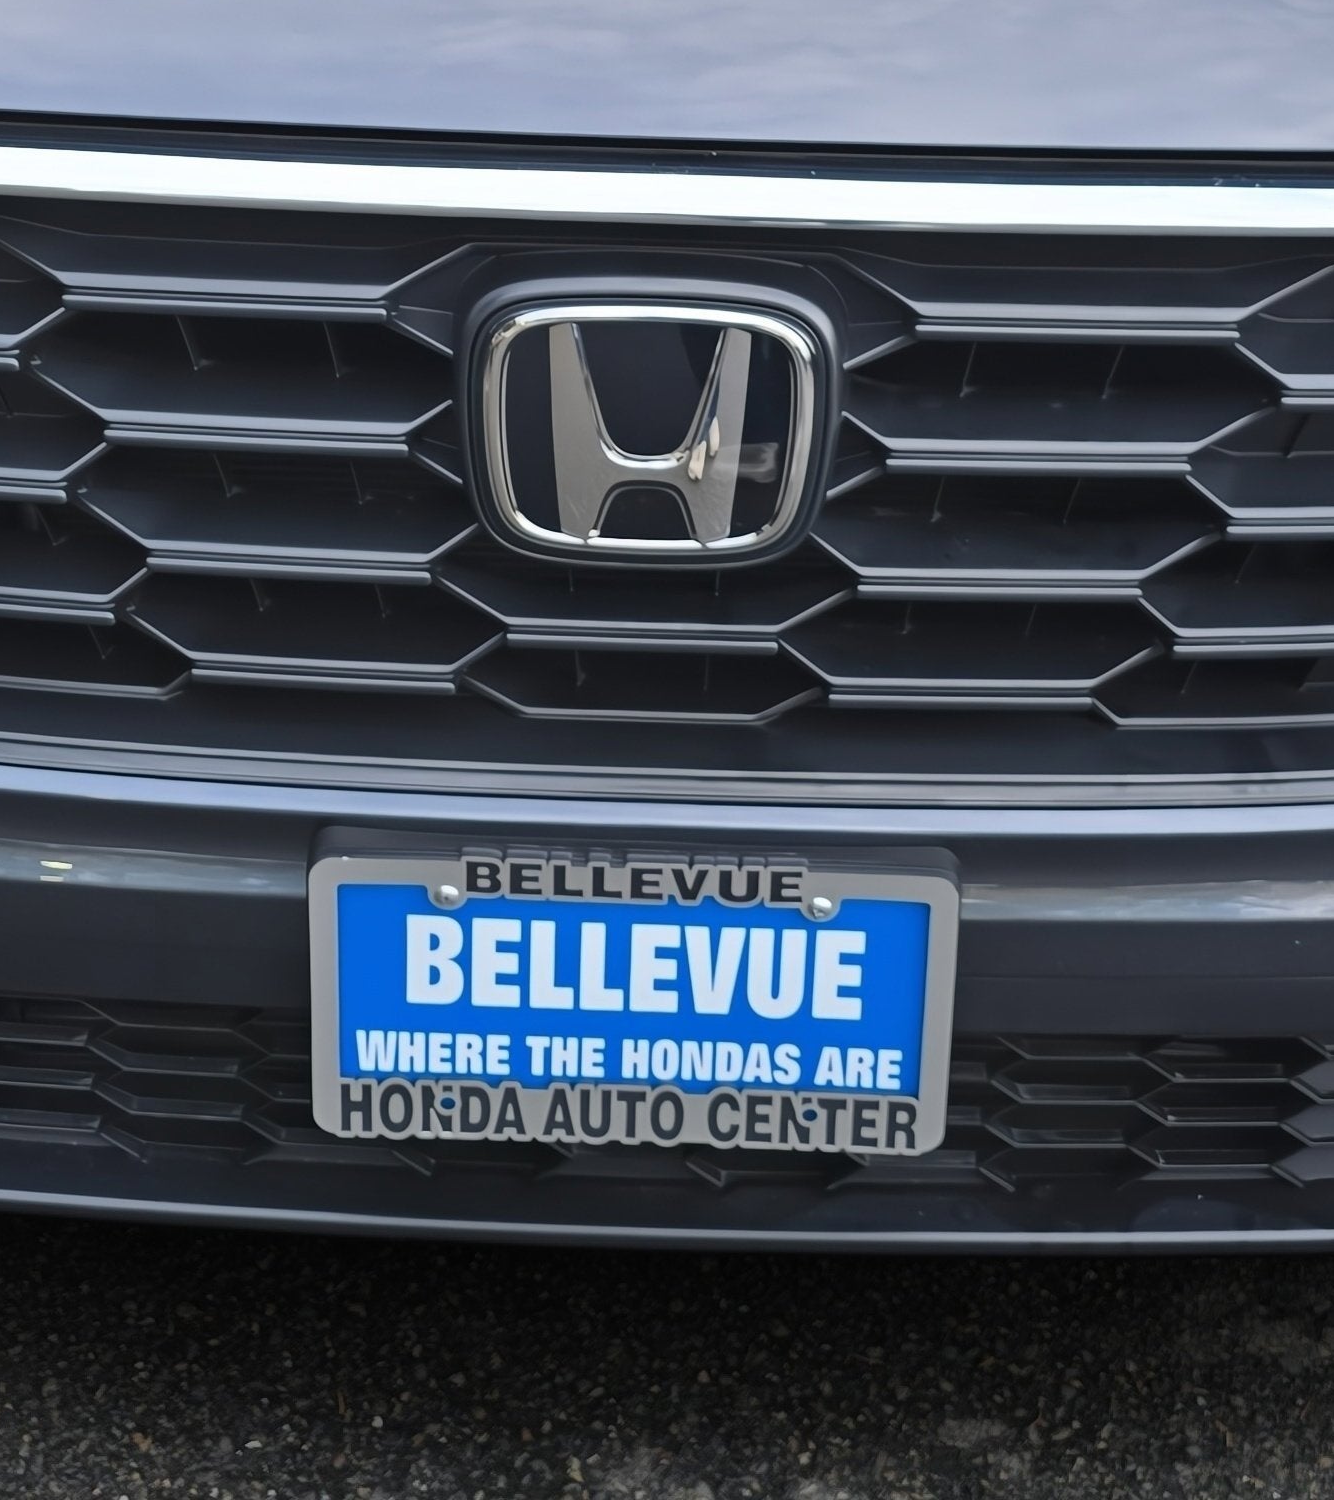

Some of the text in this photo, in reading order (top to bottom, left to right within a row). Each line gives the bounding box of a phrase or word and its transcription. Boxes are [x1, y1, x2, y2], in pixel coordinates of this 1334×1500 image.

[466, 860, 804, 902] BELLEVUE
[406, 913, 867, 1021] BELLEVUE
[356, 1029, 904, 1090] WHERE THE HONDAS ARE
[339, 1083, 918, 1150] HONDA AUTO CENTER
